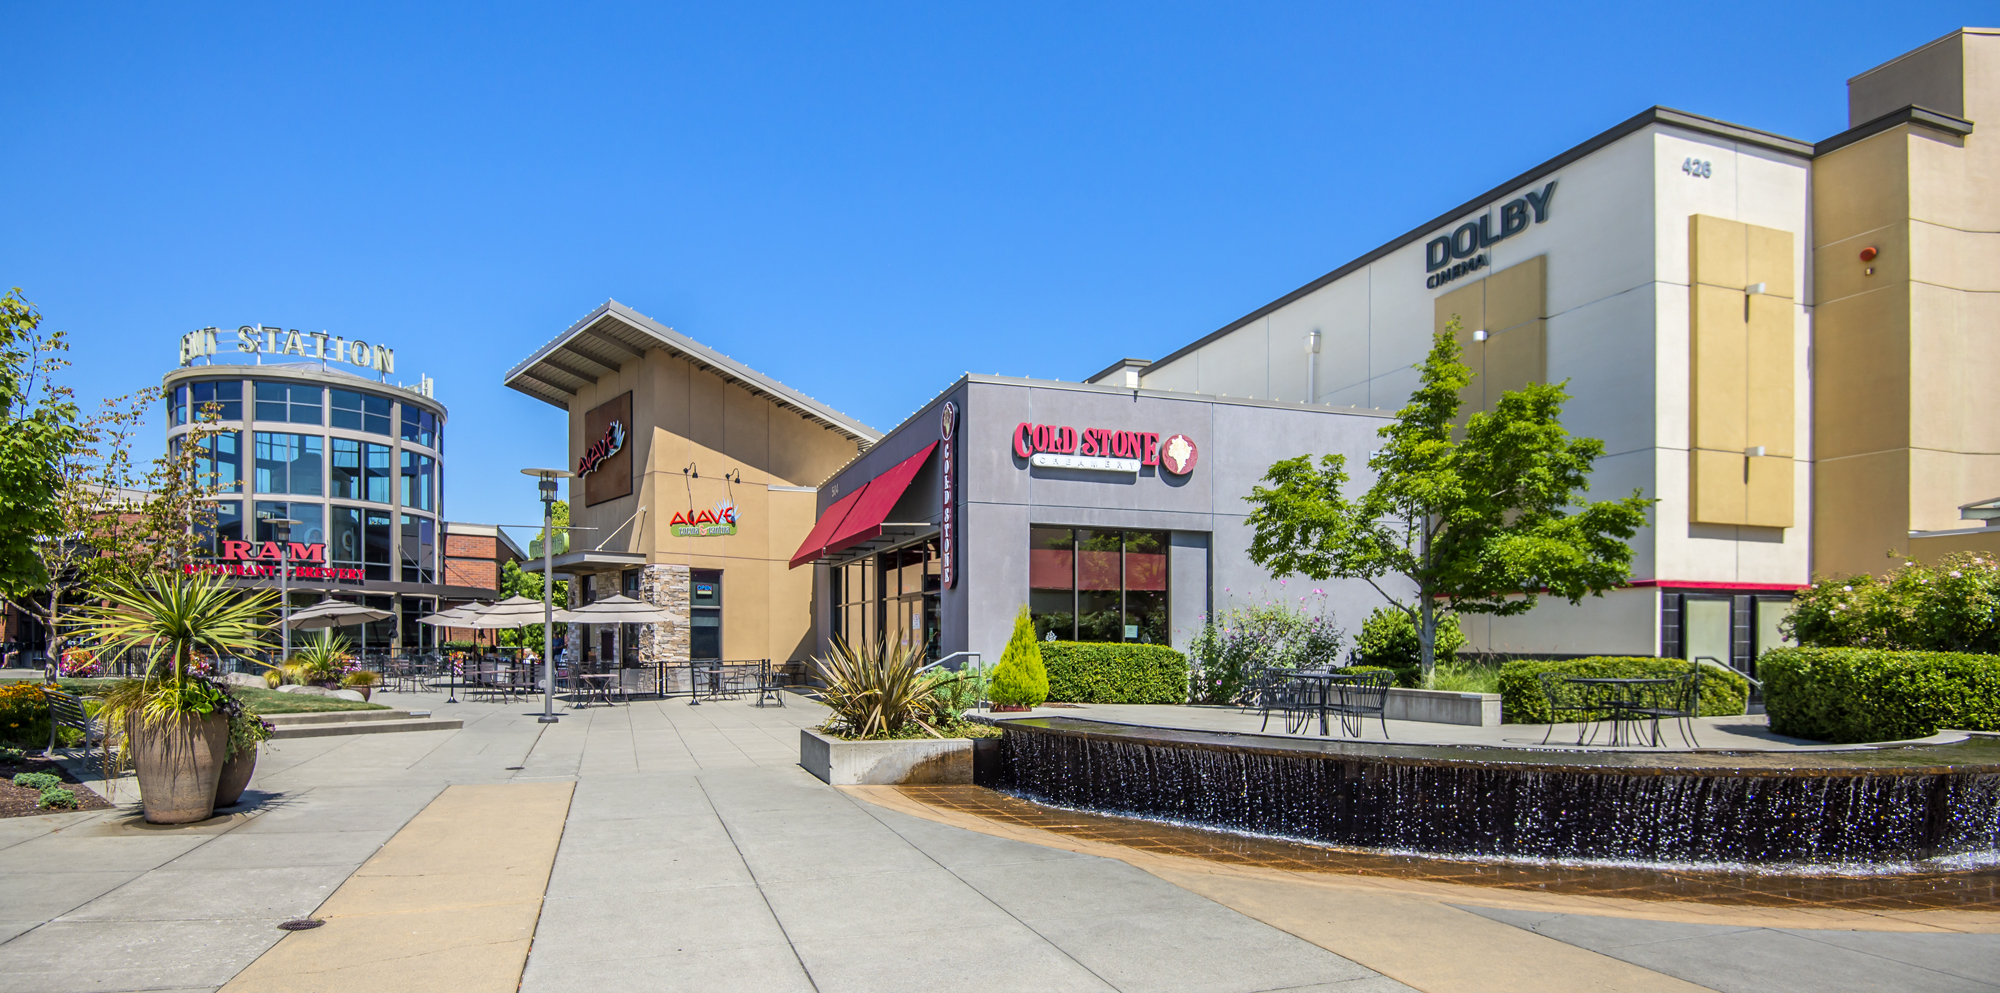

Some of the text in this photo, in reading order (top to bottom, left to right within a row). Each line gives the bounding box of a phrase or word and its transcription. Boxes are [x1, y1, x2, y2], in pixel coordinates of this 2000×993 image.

[1683, 157, 1711, 178] 426
[1426, 180, 1556, 274] DOLBY
[1426, 254, 1488, 290] CINEMA
[238, 325, 394, 374] STATION
[577, 425, 615, 478] AGAVE
[1014, 422, 1159, 466] COLD STONE
[222, 540, 325, 563] RAM
[296, 567, 366, 580] BREWERY
